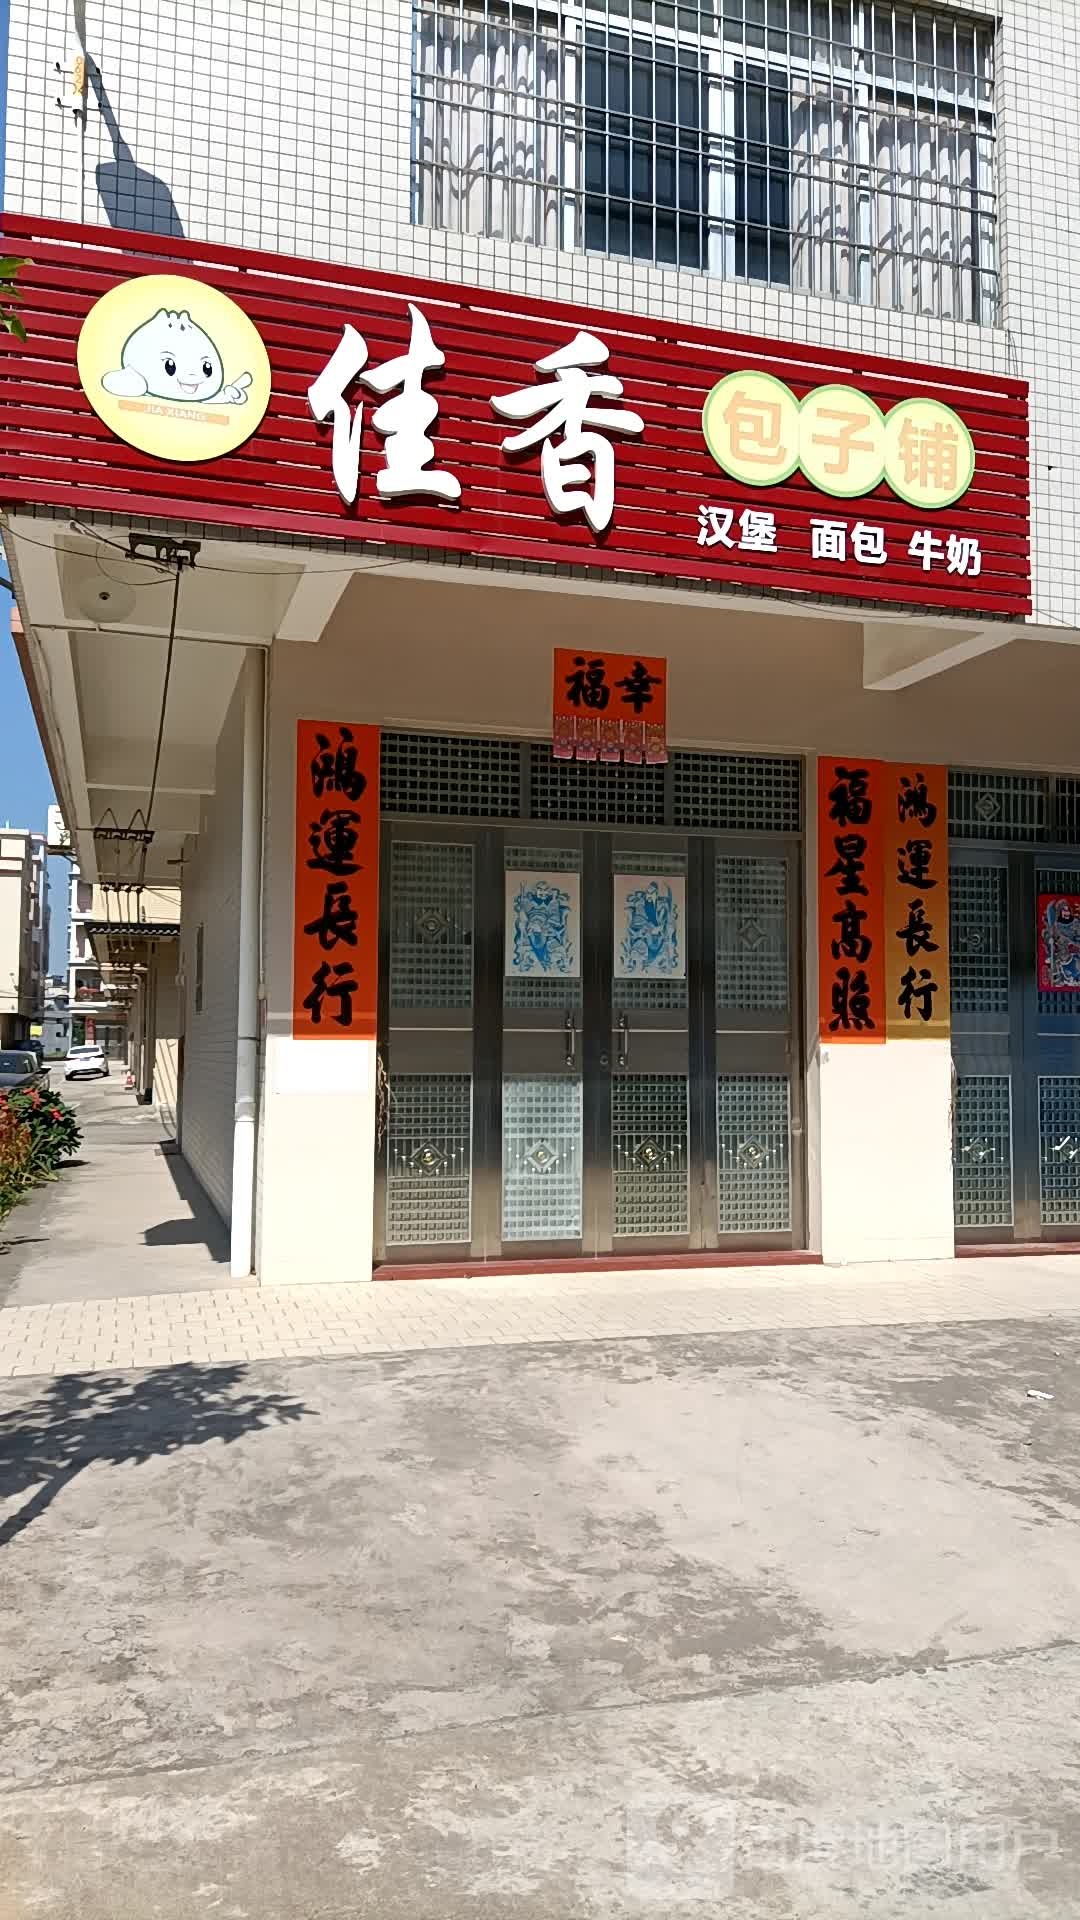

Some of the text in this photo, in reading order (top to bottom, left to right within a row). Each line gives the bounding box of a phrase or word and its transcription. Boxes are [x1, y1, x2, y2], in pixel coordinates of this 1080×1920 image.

[307, 303, 644, 533] 佳香
[723, 390, 960, 491] 包子铺
[696, 504, 982, 577] 汉堡 面包 牛奶
[825, 766, 876, 1032] 福星高照
